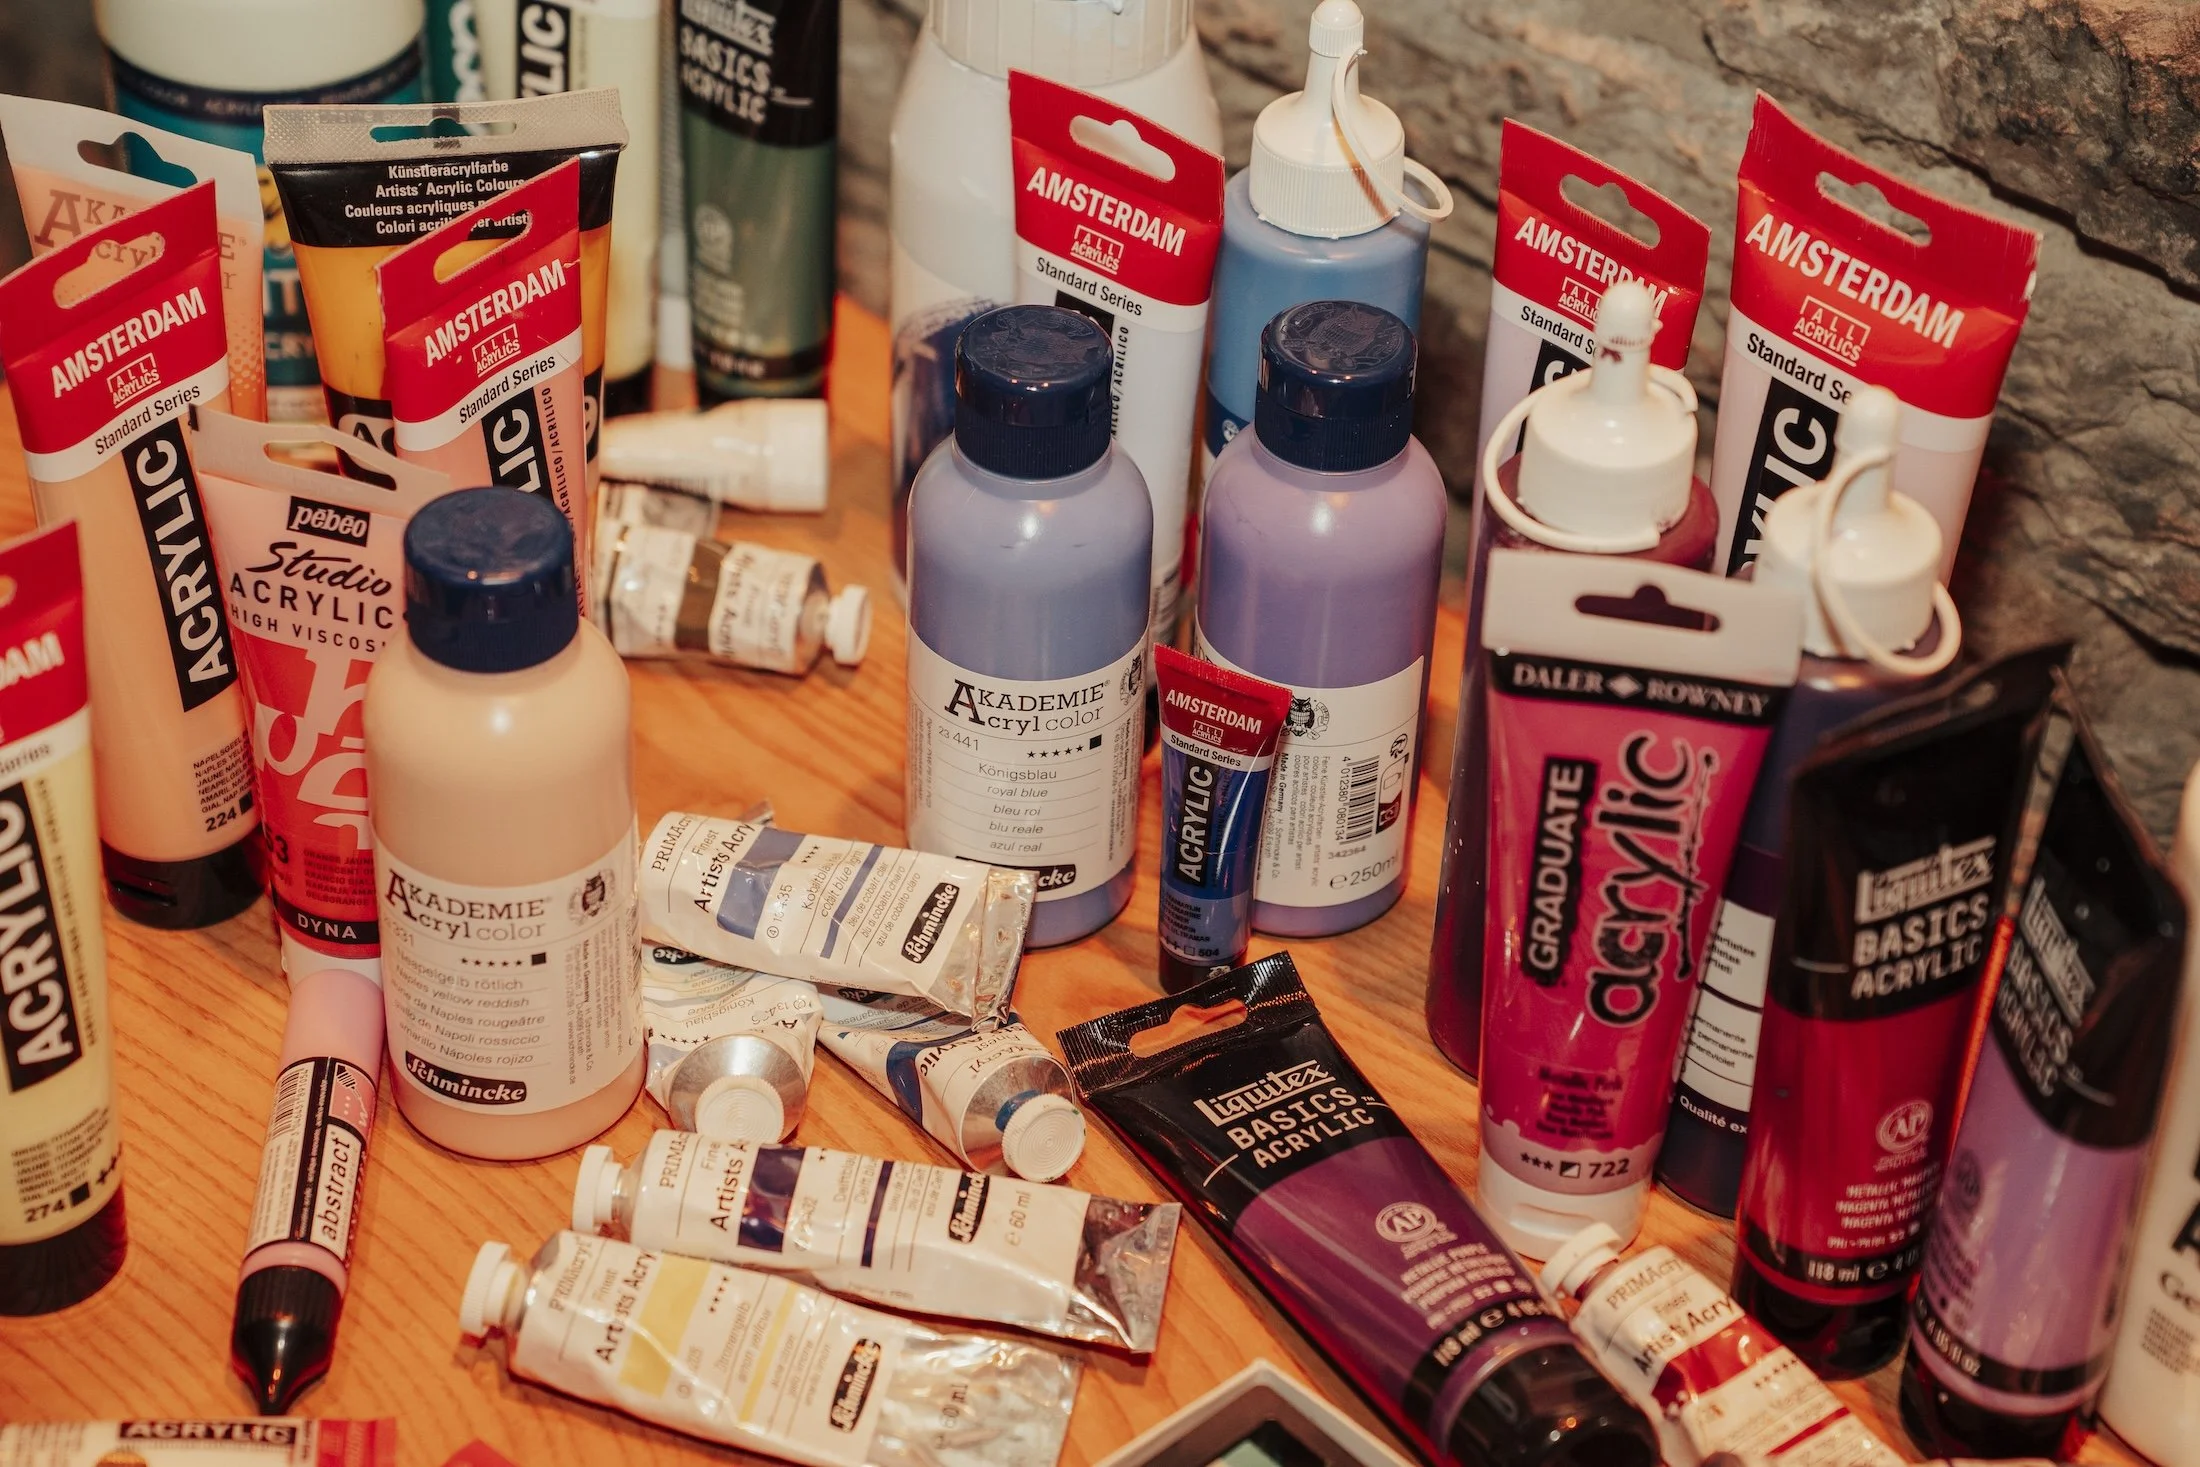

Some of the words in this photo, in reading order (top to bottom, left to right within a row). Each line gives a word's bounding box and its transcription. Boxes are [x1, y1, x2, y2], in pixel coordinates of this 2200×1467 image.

[388, 160, 509, 179] Künstleracrylfarbe
[427, 180, 473, 197] Acrylic
[345, 204, 404, 219] Couleurs
[407, 201, 475, 218] acryliques
[376, 219, 416, 235] Colori
[1026, 167, 1187, 257] AMSTERDAM
[1071, 241, 1120, 271] ACRYLICS
[1515, 216, 1669, 319] AMSTERDM
[1036, 257, 1096, 296] Standard
[1100, 286, 1143, 316] Series
[1745, 213, 1966, 349] AMSTERDAM
[424, 258, 566, 367] AMSTERDAM
[1520, 305, 1584, 348] Standard
[51, 287, 207, 398] AMSTERDAM
[476, 340, 520, 375] ACRYLICS
[1794, 317, 1863, 361] ACRYLICS
[1747, 332, 1826, 393] Standard
[112, 369, 160, 405] ACRYLICS
[459, 378, 510, 424] Standard
[512, 355, 557, 389] Series
[95, 408, 152, 456] Standard
[155, 384, 201, 417] Series
[136, 439, 229, 683] ACRYLIC
[246, 542, 393, 597] Studio
[230, 572, 394, 629] ACRYLIC
[231, 604, 279, 632] HIGH
[945, 679, 1105, 727] AKADEMIE
[1512, 662, 1605, 694] DALER
[1646, 679, 1770, 717] ROWNEY
[1166, 690, 1263, 735] AMSTERDAM
[1170, 735, 1210, 759] Standard
[1212, 751, 1241, 767] Series
[1192, 728, 1222, 744] ACRYLICS
[978, 763, 1058, 782] Königsblau
[1280, 752, 1289, 773] Made
[987, 785, 1018, 798] royal
[1021, 788, 1048, 798] blue
[993, 804, 1021, 816] bleu
[1024, 806, 1041, 816] roi
[1277, 782, 1287, 813] Germany
[205, 807, 237, 832] 224
[989, 822, 1009, 833] blu
[1012, 823, 1044, 835] reale
[1178, 765, 1214, 883] ACRYLIC
[692, 829, 719, 857] Finest
[989, 840, 1016, 852] azul
[1018, 842, 1042, 852] real
[1528, 763, 1585, 971] GRADUATE
[1588, 733, 1708, 1024] acrylic
[386, 869, 546, 922] AKADEMIE
[820, 889, 839, 918] cobalt
[836, 866, 850, 890] blue
[848, 911, 859, 928] bleu
[857, 901, 865, 913] de
[863, 876, 881, 905] cobalt
[876, 861, 889, 879] clair
[861, 924, 870, 938] blu
[874, 890, 892, 920] cobalto
[889, 866, 906, 893] chiaro
[876, 929, 887, 947] azul
[884, 917, 895, 930] de
[892, 893, 910, 922] cobalto
[906, 872, 921, 895] claro
[297, 912, 358, 940] DYNA
[902, 882, 959, 963] Schmincke
[1853, 892, 1990, 968] BASICS
[475, 975, 523, 991] rötlich
[1851, 933, 1984, 1000] ACRYLIC
[430, 1004, 474, 1026] Naples
[477, 1014, 546, 1030] rougeâtre
[432, 988, 473, 1006] yellow
[477, 997, 529, 1009] reddish
[685, 997, 755, 1028] Königsblau
[435, 1024, 475, 1044] Napoli
[479, 1033, 540, 1047] rossiccio
[439, 1043, 493, 1064] Nápoles
[496, 1053, 534, 1066] rojizo
[407, 1058, 526, 1101] Schmincke
[1194, 1060, 1336, 1127] Liquitex
[1227, 1087, 1357, 1150] BASICS
[1679, 1093, 1727, 1129] Qualité
[1253, 1107, 1375, 1169] ACRYLIC
[317, 1136, 350, 1242] abstract
[1588, 1158, 1631, 1179] 722
[25, 1199, 65, 1222] 274
[1009, 1209, 1027, 1230] 60
[1016, 1190, 1031, 1211] ml
[125, 1422, 290, 1444] ACRYLIC
